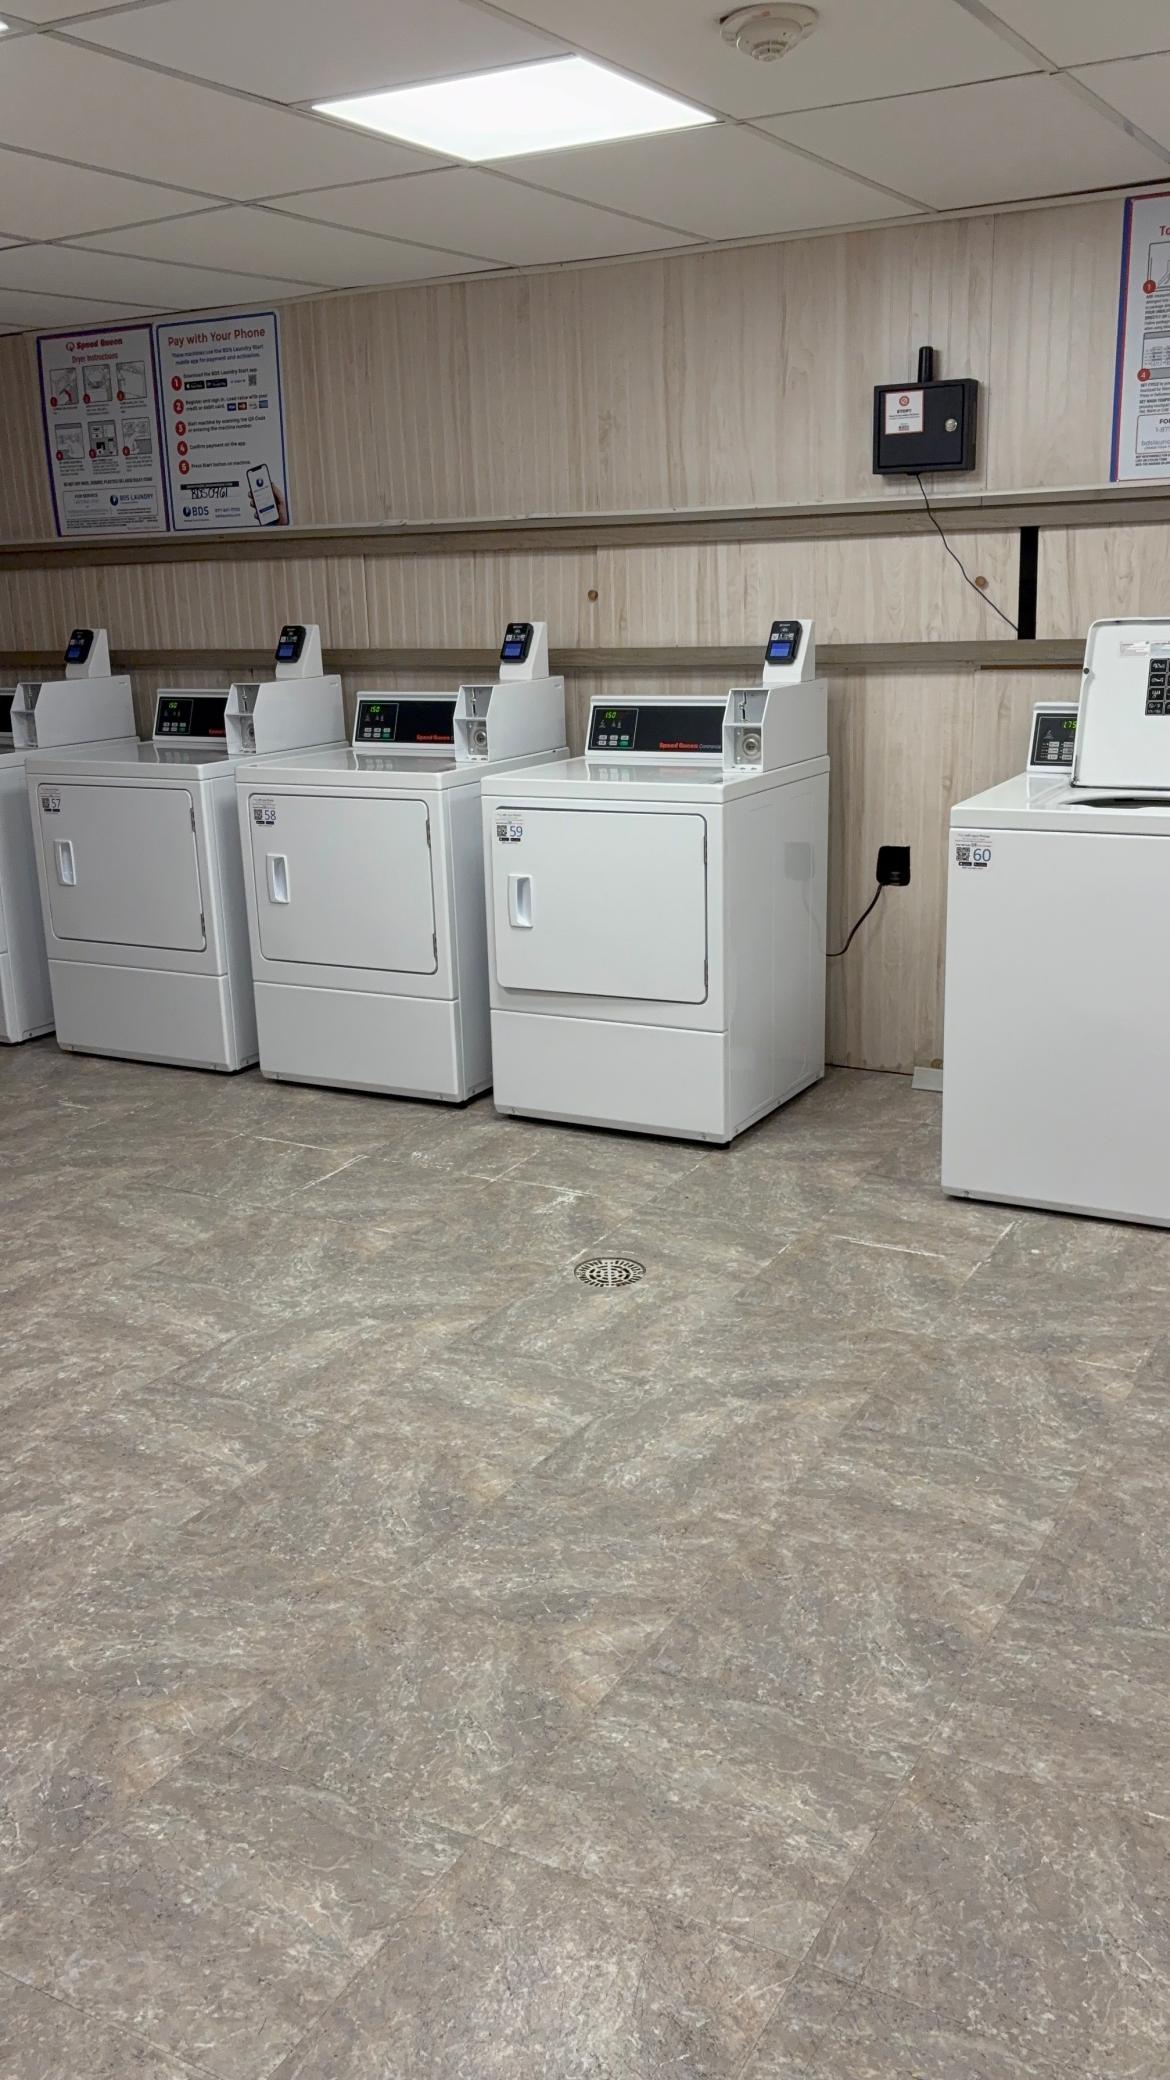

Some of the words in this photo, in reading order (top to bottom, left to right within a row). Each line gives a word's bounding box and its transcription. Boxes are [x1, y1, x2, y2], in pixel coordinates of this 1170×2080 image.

[168, 337, 185, 348] Pay
[187, 333, 208, 344] with
[210, 331, 231, 342] Your
[234, 328, 266, 339] Phone
[76, 340, 98, 350] Speed
[101, 338, 123, 347] Queen
[1140, 370, 1146, 379] 4
[176, 400, 183, 411] 2
[192, 506, 209, 516] BDS
[605, 711, 616, 719] 150
[265, 809, 276, 820] 58
[510, 826, 522, 837] 59
[973, 848, 991, 862] 60
